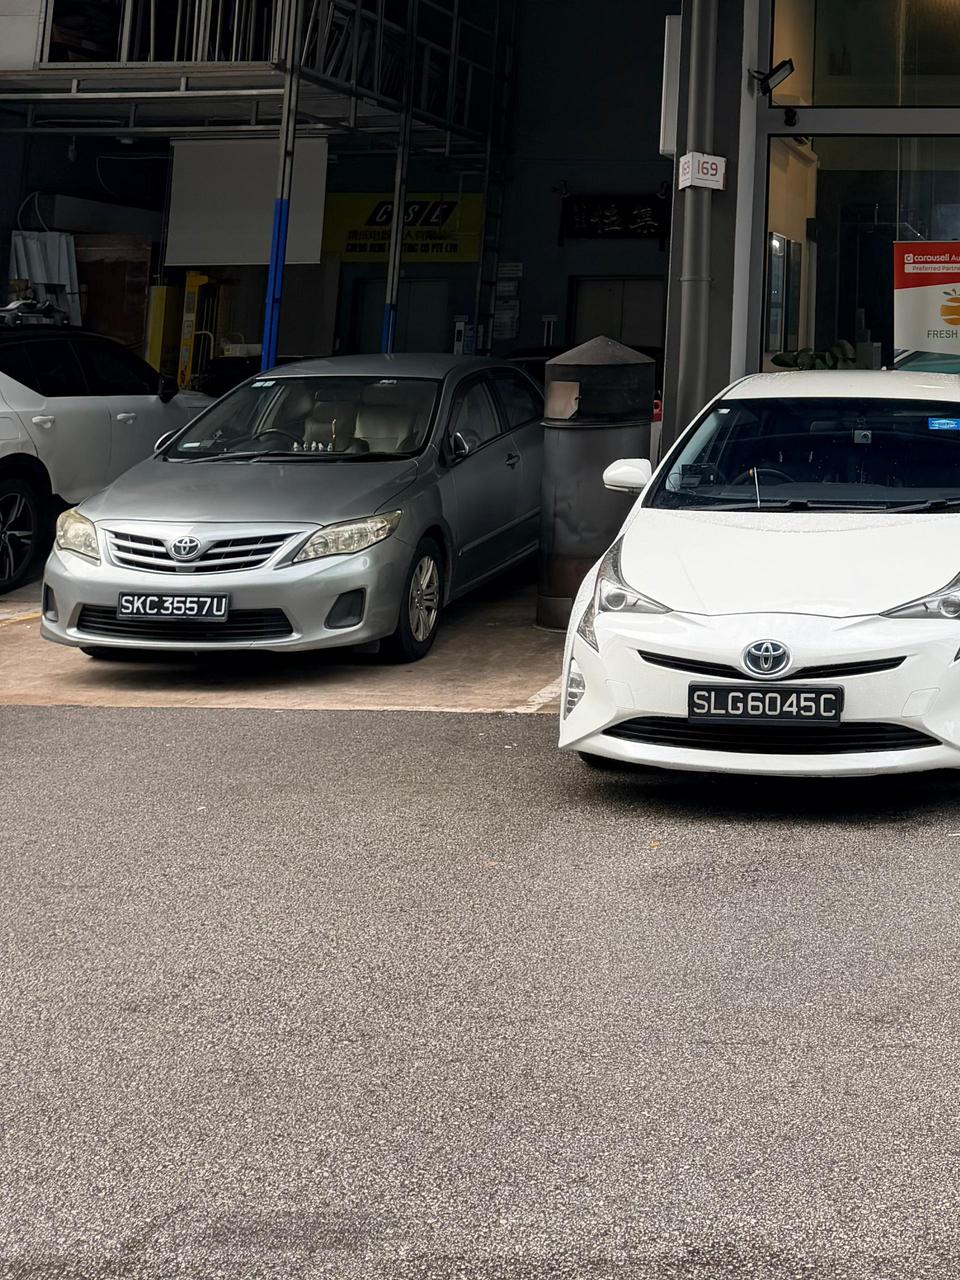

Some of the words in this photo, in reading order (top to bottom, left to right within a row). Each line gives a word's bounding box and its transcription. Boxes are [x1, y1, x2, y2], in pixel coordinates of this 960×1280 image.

[697, 160, 718, 177] 169
[914, 253, 950, 262] carousell
[927, 329, 958, 339] FRESH
[120, 595, 226, 616] SKC3557U
[693, 690, 836, 717] SLG6045C
